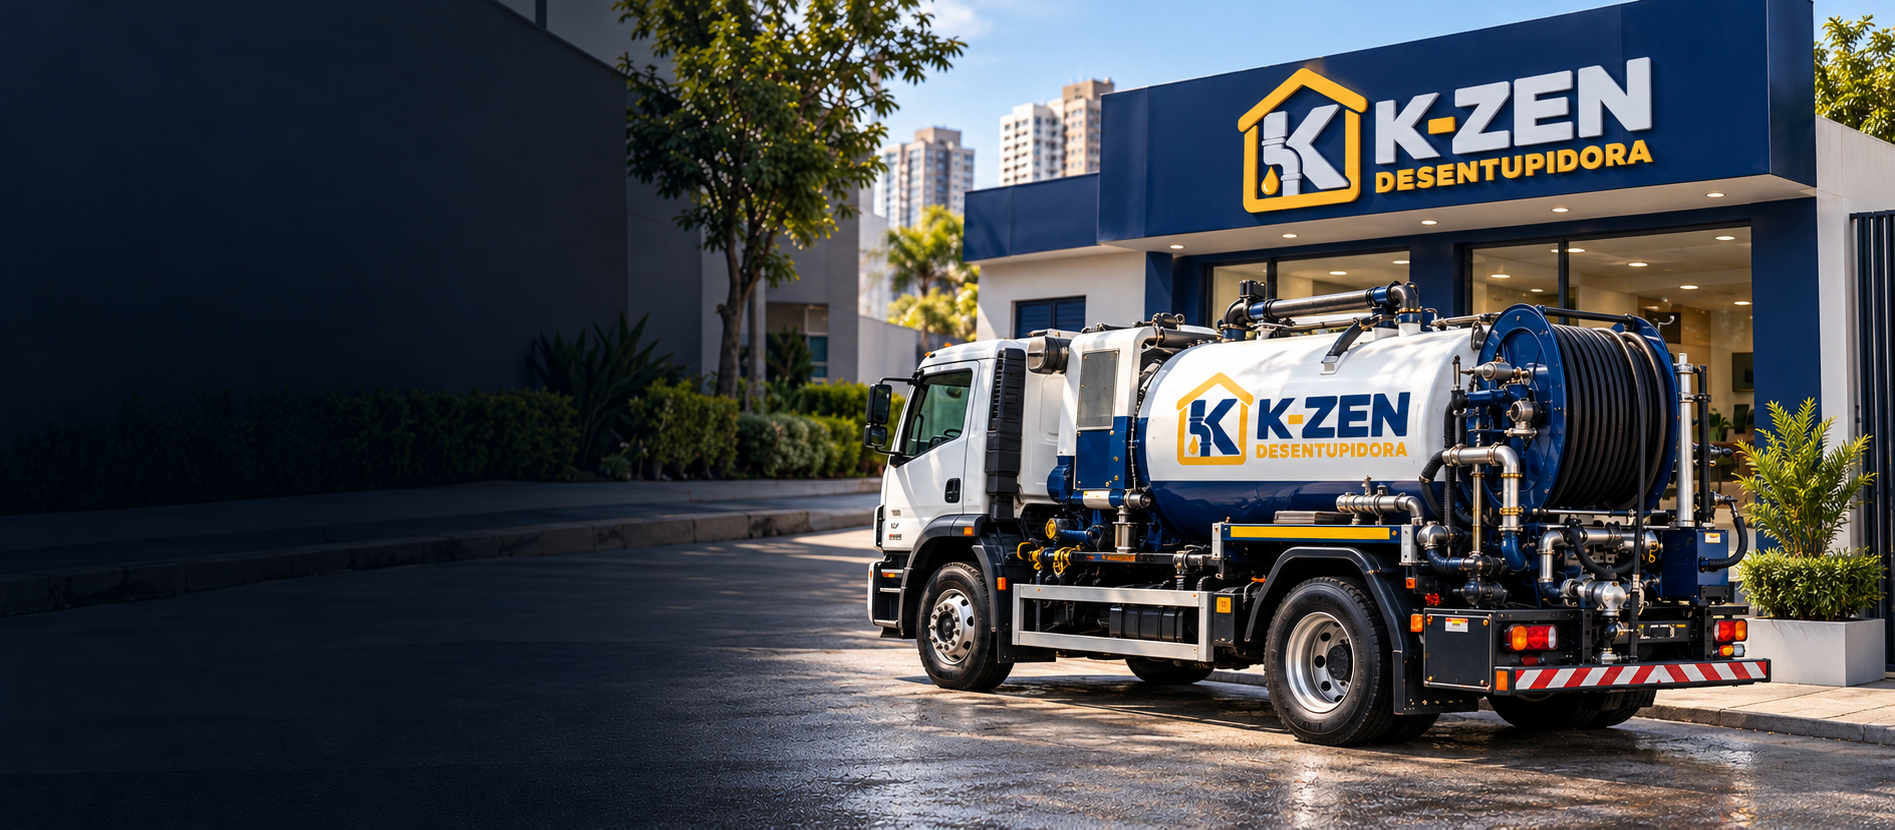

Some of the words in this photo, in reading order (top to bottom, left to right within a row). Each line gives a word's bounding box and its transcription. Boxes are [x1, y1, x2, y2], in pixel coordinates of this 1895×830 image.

[1375, 56, 1653, 165] K-ZEN
[1375, 139, 1653, 194] DESENTUPIDORA
[1256, 391, 1411, 440] K-ZEN
[1256, 442, 1408, 459] DESENTUPIDORA
